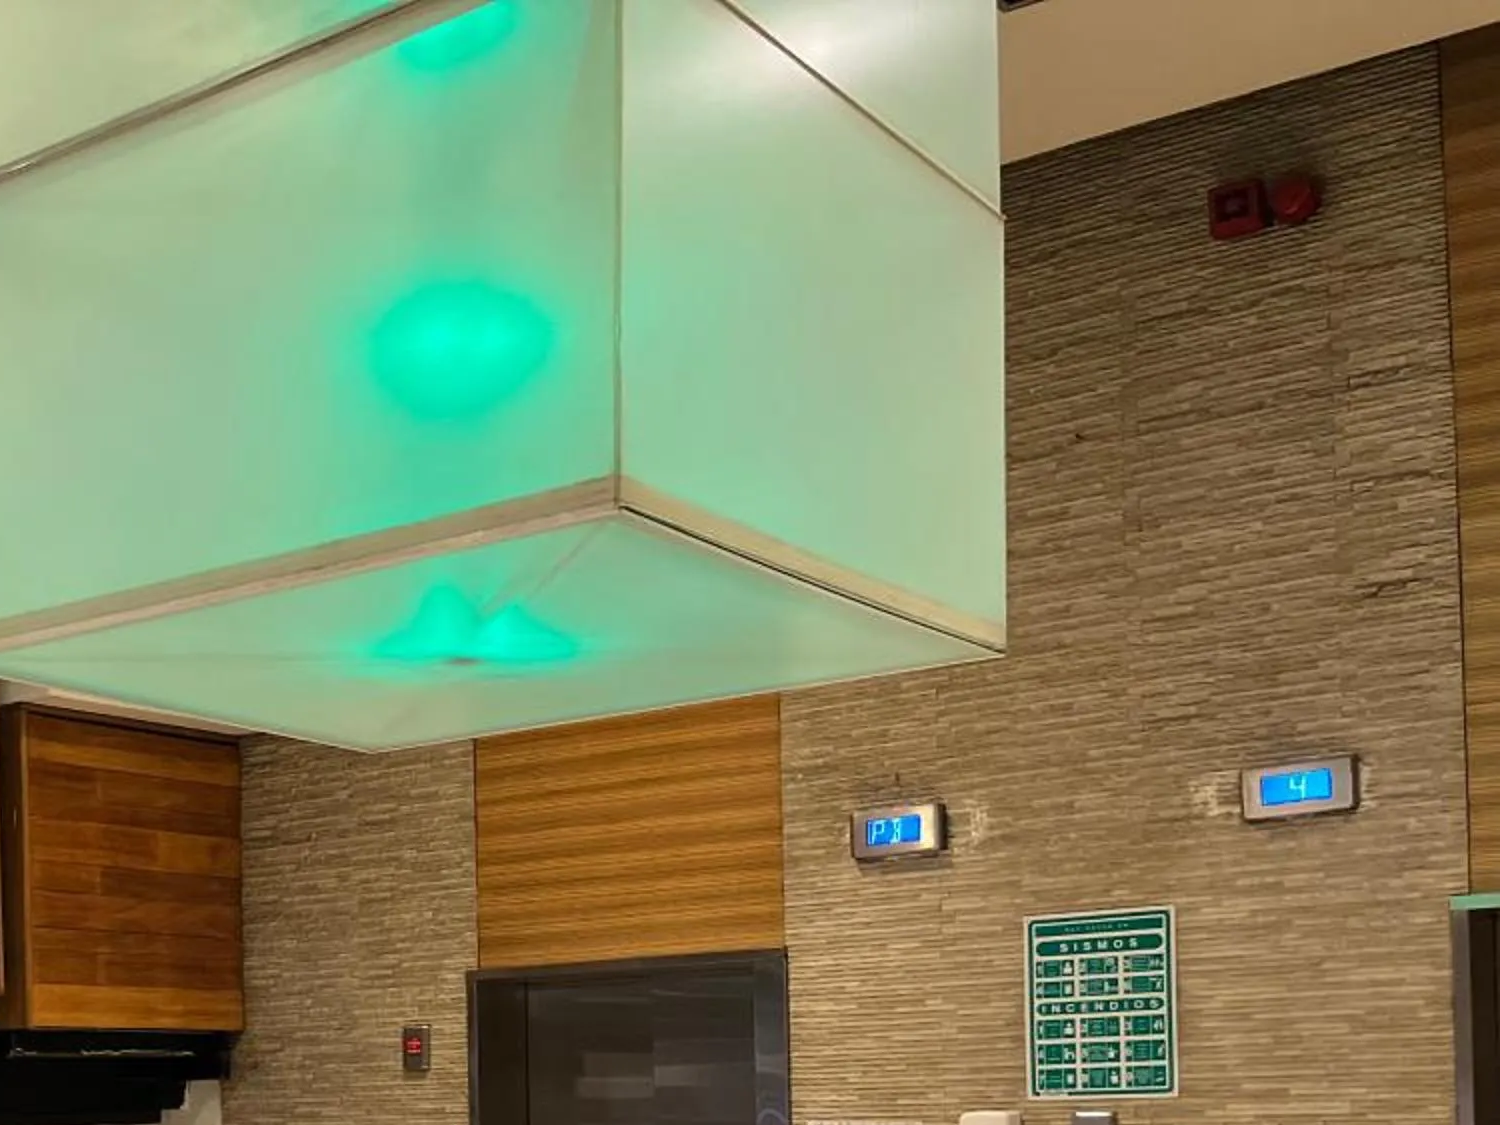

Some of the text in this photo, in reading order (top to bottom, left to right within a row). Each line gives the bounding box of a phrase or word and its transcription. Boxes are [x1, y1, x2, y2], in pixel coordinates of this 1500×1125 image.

[1289, 774, 1306, 800] 4
[1059, 937, 1138, 953] SISMOS
[1041, 999, 1160, 1014] INCENDIOS
